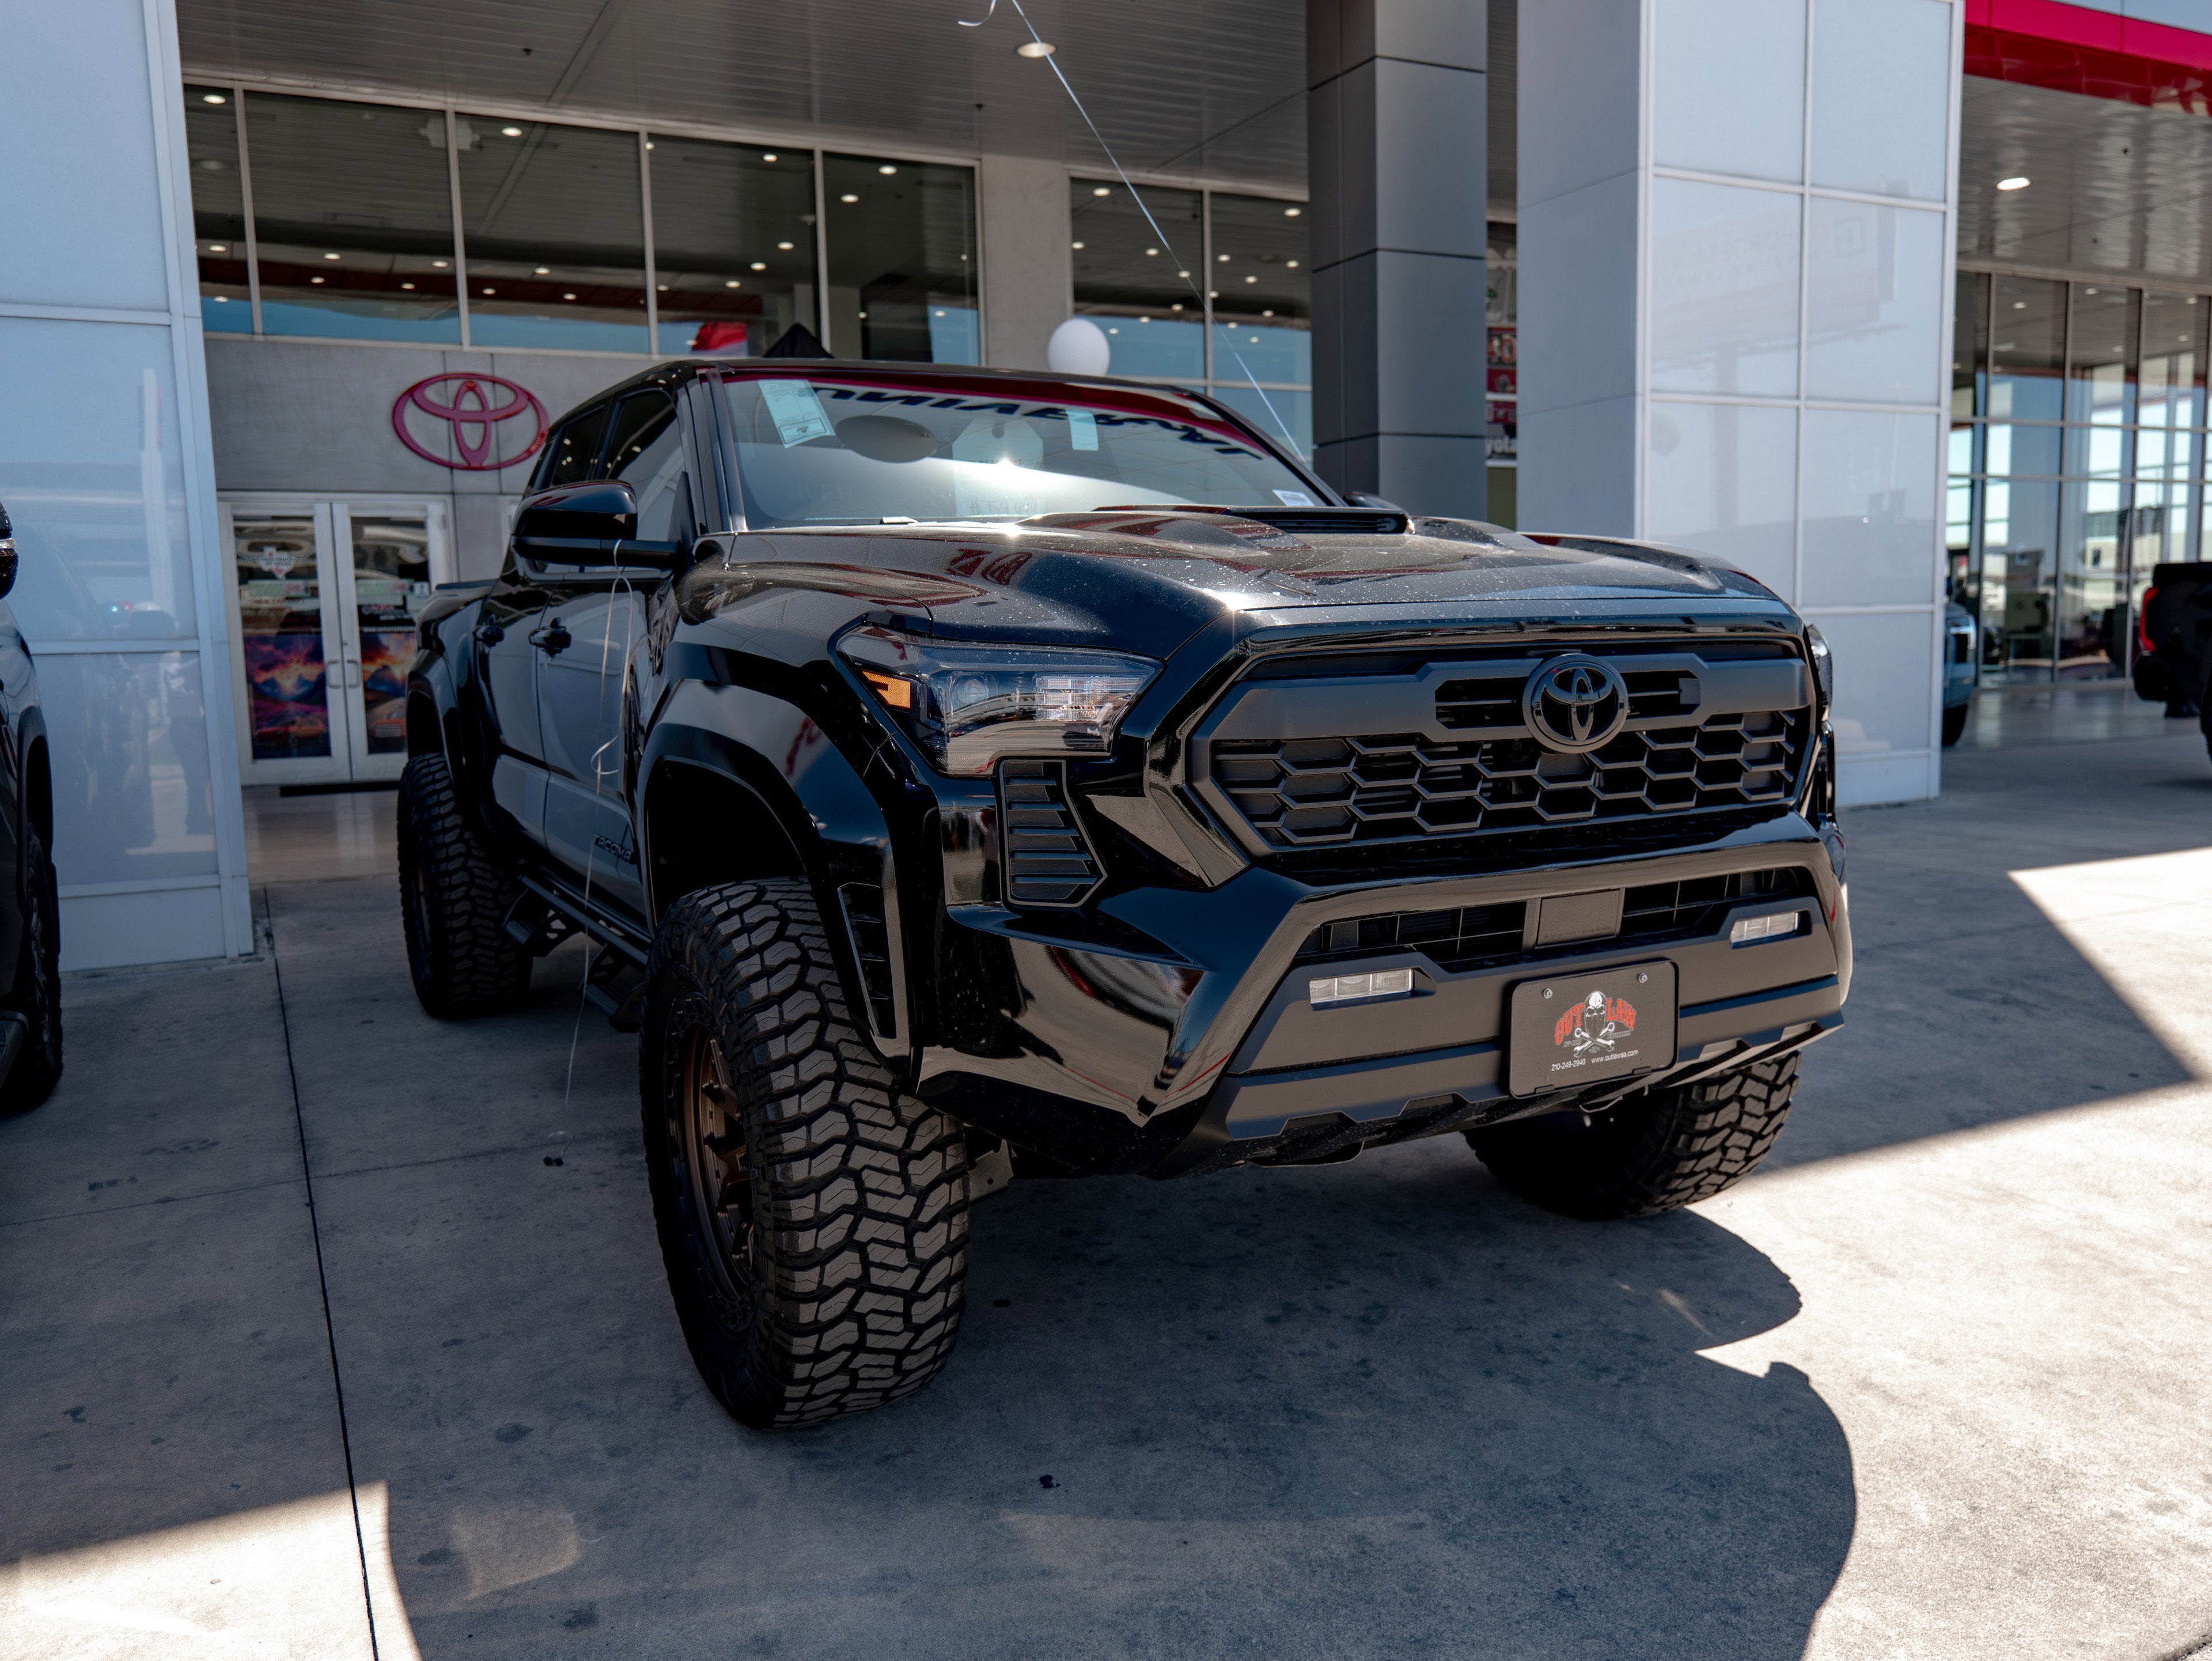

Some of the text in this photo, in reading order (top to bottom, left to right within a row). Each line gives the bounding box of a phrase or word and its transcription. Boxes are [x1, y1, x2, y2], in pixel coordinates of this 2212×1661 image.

[592, 833, 632, 864] TACOMA
[1555, 998, 1637, 1045] OUT LAW
[1551, 1058, 1586, 1072] 210-249-2940
[1591, 1050, 1638, 1064] www.outlawsa.com
